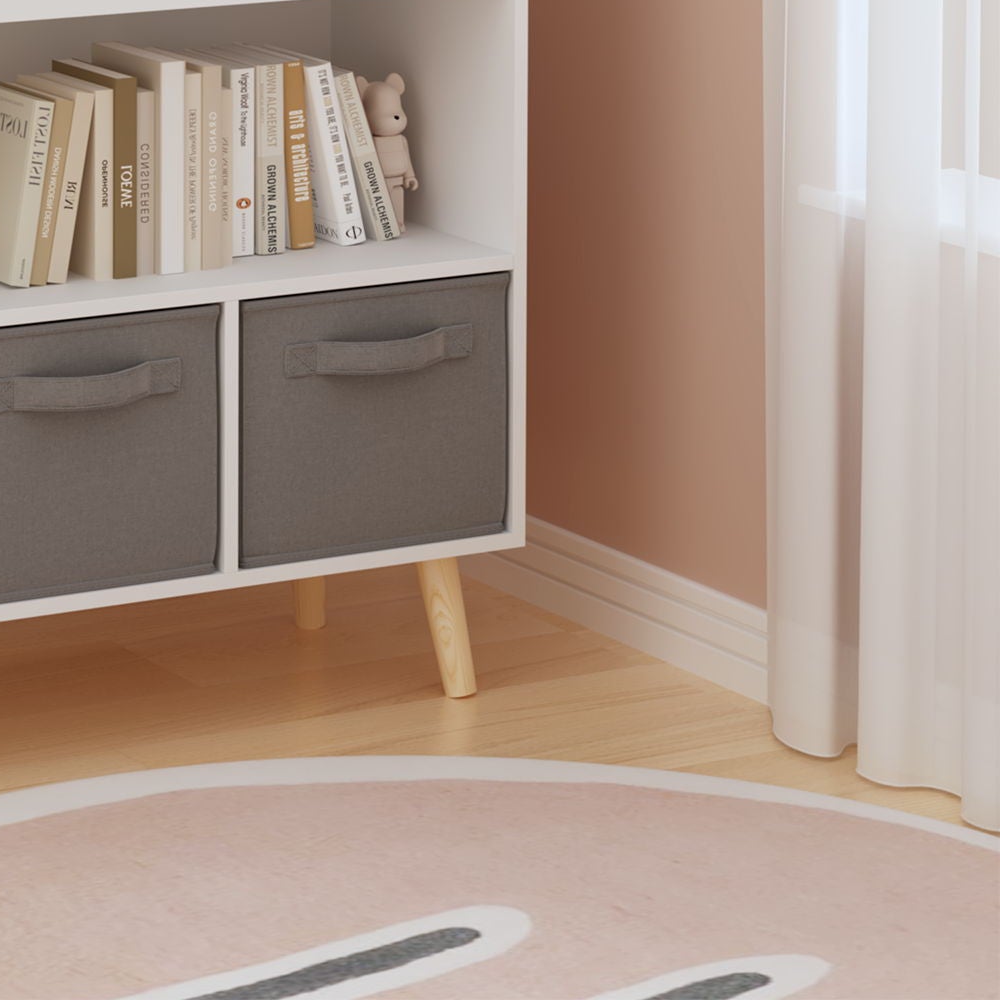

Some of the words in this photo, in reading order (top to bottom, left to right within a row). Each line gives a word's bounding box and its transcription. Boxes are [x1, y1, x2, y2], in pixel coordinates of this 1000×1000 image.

[237, 72, 249, 94] Virginia
[240, 93, 249, 109] Woolf
[266, 96, 278, 148] ALCHEMIST
[288, 109, 306, 131] arts
[347, 102, 369, 148] ALCHEMIST
[266, 164, 277, 201] GROWN
[291, 143, 310, 203] architecture
[363, 161, 381, 194] GROWN
